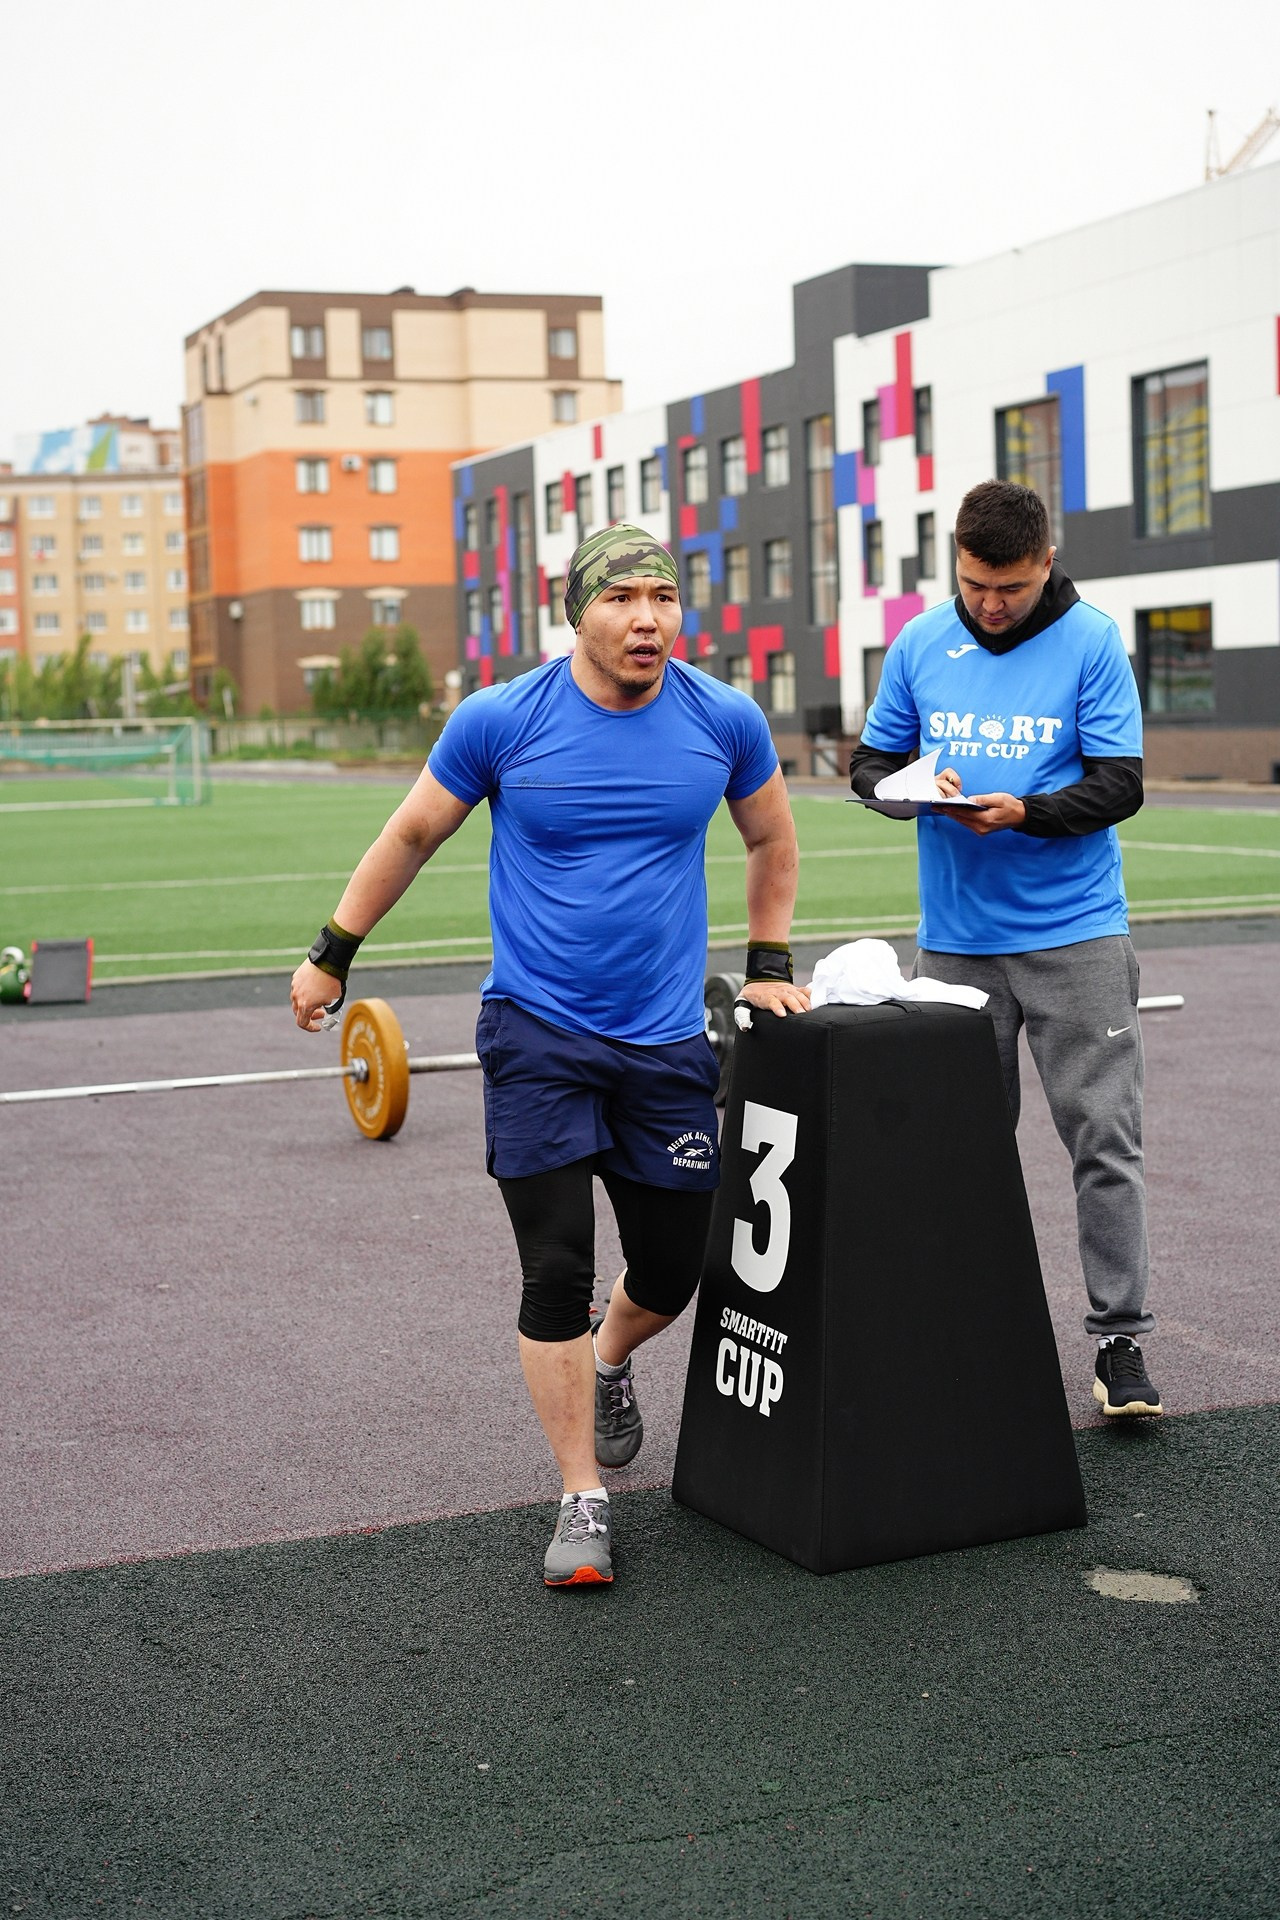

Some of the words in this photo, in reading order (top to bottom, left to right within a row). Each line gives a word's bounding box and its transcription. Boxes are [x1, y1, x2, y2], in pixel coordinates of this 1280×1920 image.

[948, 740, 983, 757] FIT
[985, 742, 1030, 760] CUP
[666, 1131, 694, 1154] REEBOK
[672, 1156, 711, 1170] DEPARTMENT
[730, 1100, 799, 1293] 3
[719, 1306, 789, 1355] SMARTFIT
[715, 1337, 784, 1418] CUP
